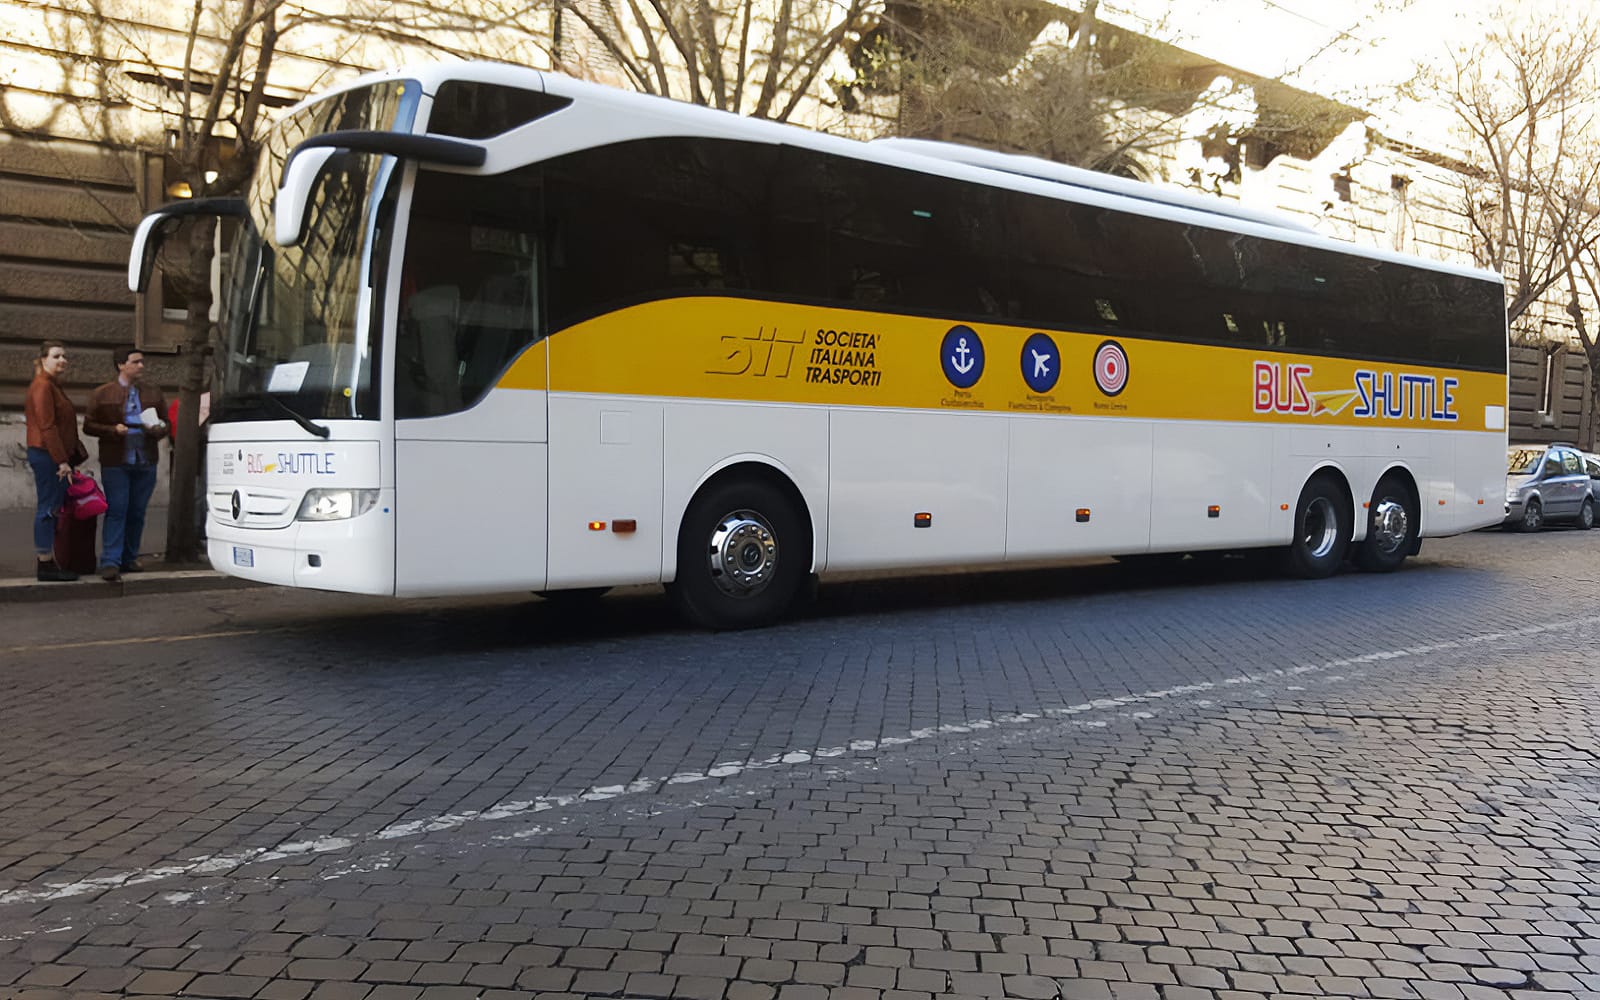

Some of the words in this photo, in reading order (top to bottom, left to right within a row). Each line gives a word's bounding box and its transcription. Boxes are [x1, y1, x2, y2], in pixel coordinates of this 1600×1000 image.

[815, 329, 881, 350] SOCIETA'
[810, 348, 875, 368] ITALIANA
[806, 366, 881, 387] TRASPORTI
[1253, 360, 1312, 415] BUS
[1353, 369, 1459, 421] SHUTTLE
[277, 452, 336, 474] SHUTTLE
